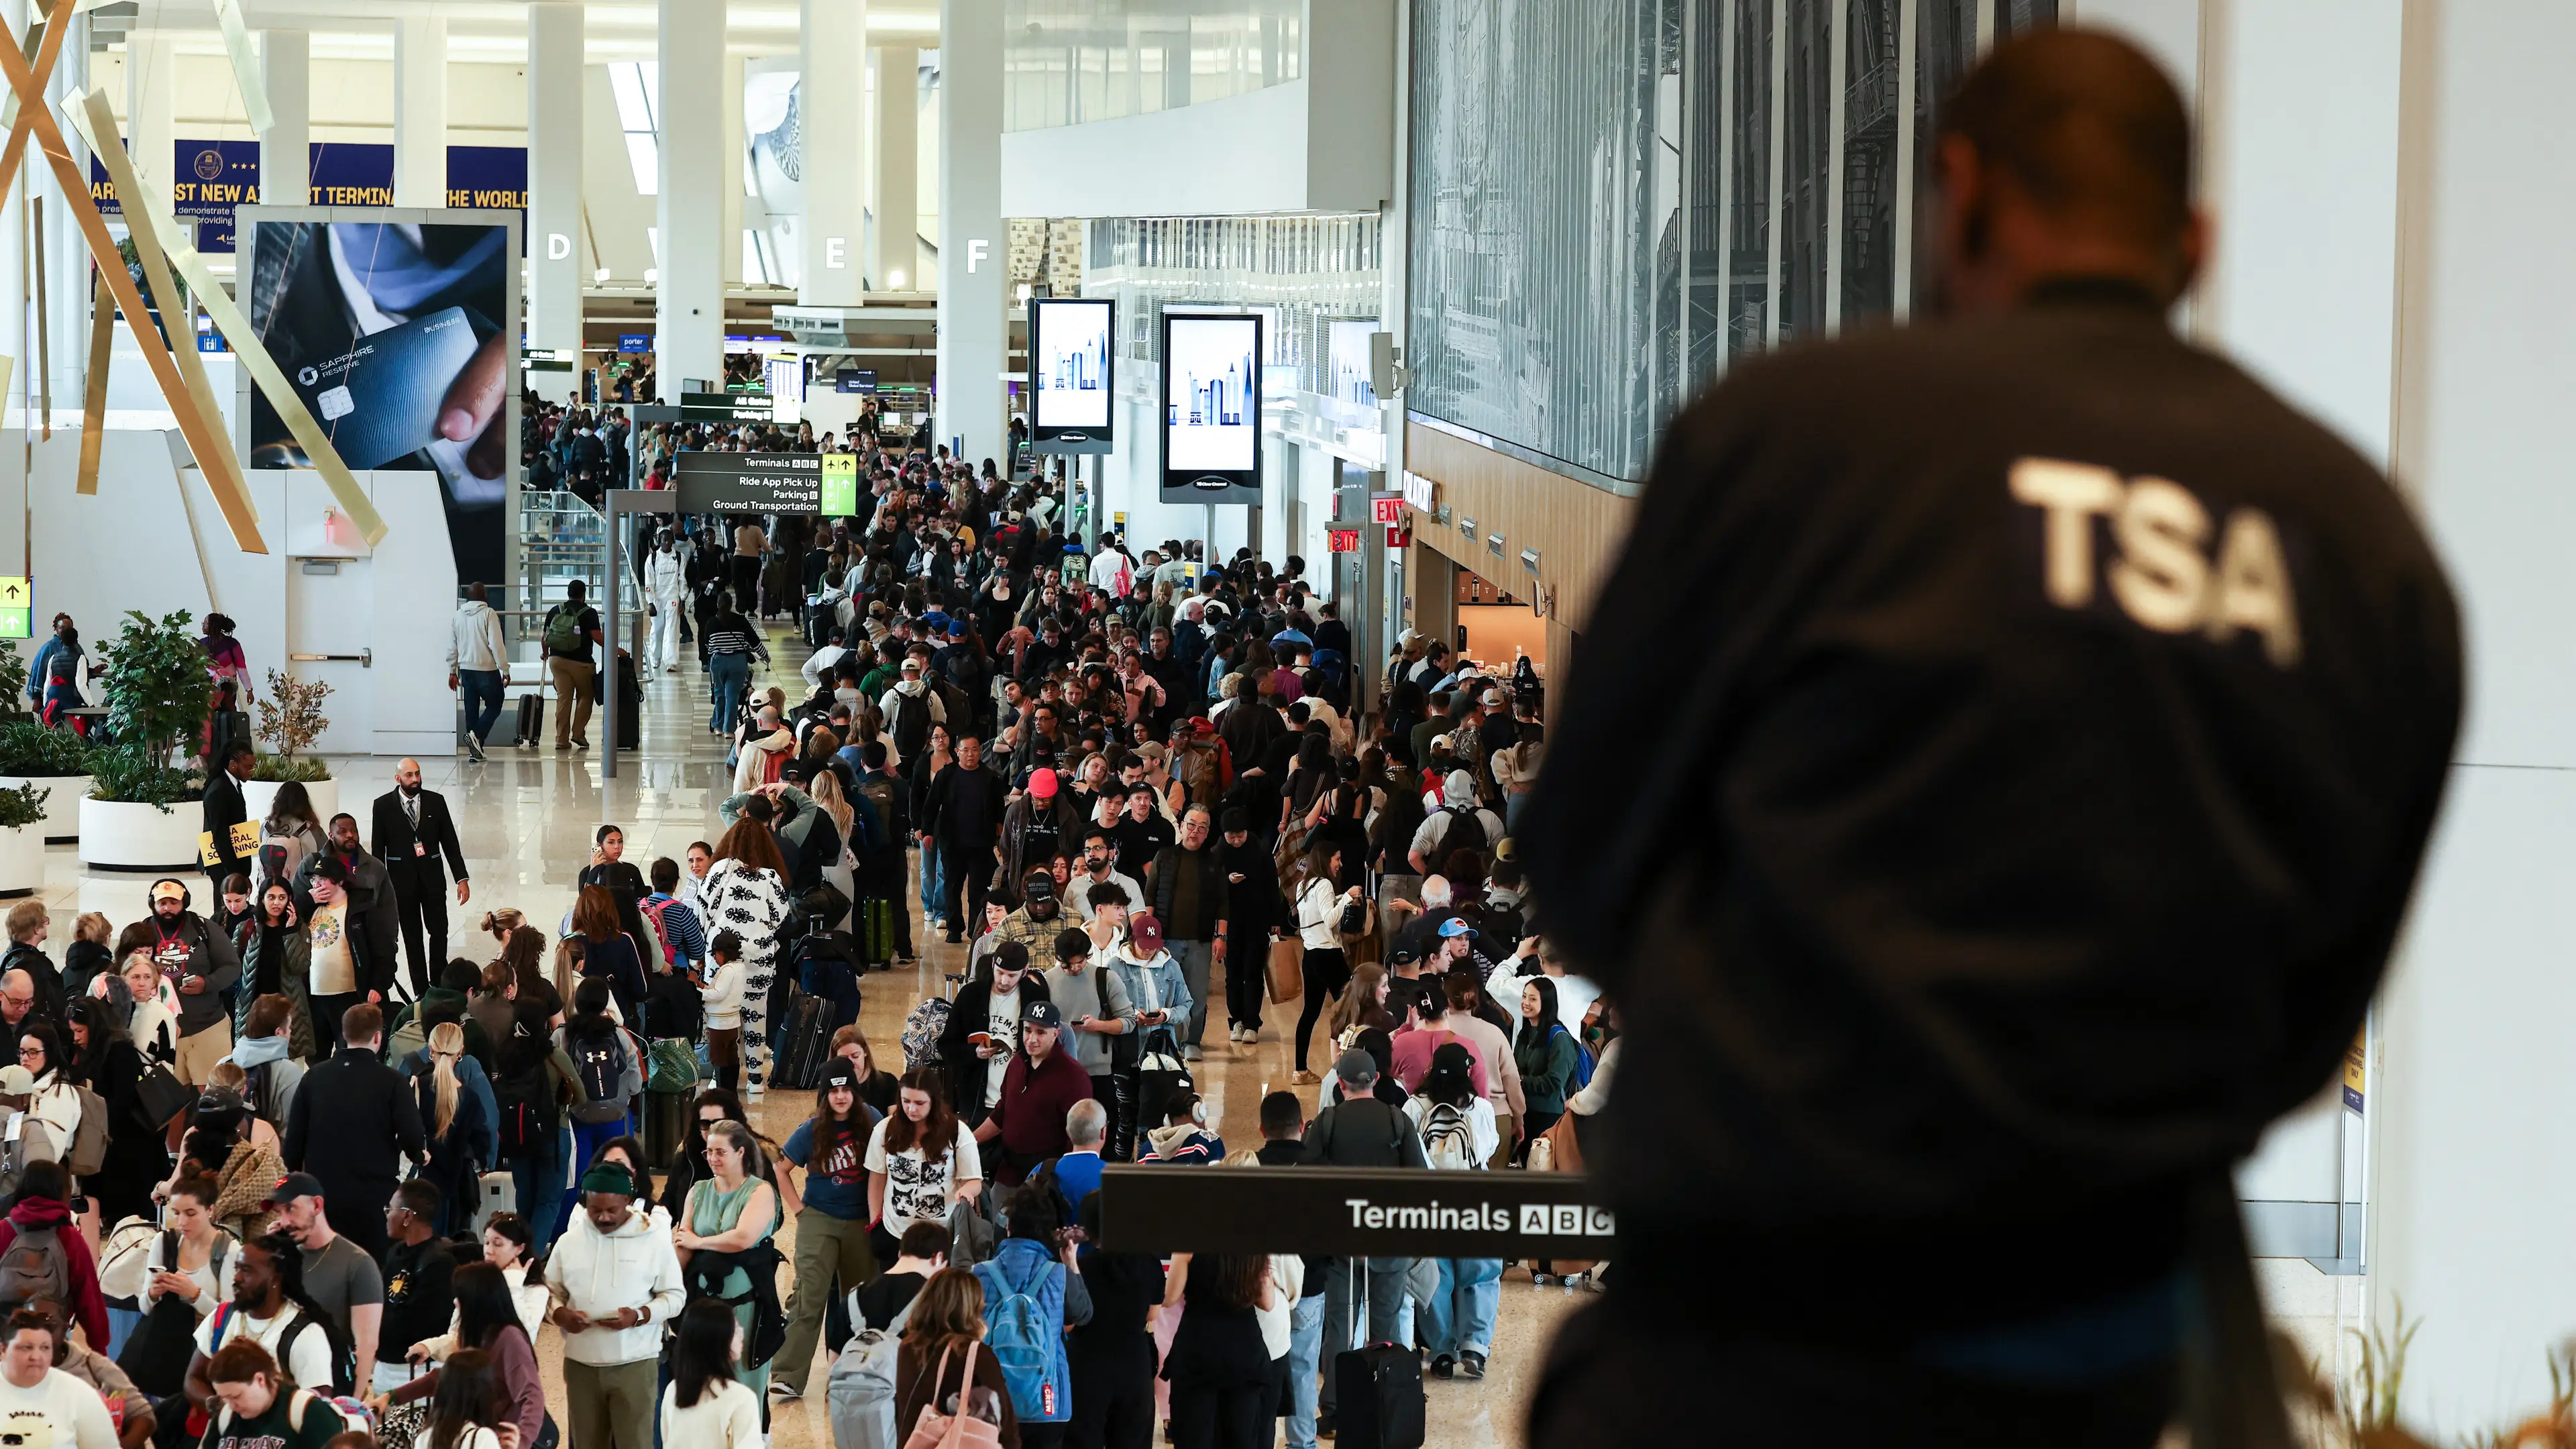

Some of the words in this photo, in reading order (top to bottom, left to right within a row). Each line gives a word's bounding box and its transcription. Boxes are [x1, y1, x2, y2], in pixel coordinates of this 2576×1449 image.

[174, 183, 197, 202] ST
[201, 183, 241, 203] NEW
[327, 186, 394, 205] TERMIN
[474, 190, 528, 209] WORLD
[178, 206, 229, 215] demonstrate
[197, 216, 233, 226] providing
[547, 233, 571, 260] D
[825, 237, 846, 269] E
[967, 239, 989, 274] F
[424, 317, 460, 333] BUSINESS
[319, 345, 374, 371] SAPPHIRE
[322, 360, 360, 378] RESERVE
[744, 458, 790, 468] Terminals
[739, 476, 760, 486] Ride
[762, 477, 782, 488] App
[783, 478, 803, 487] Pick
[805, 479, 818, 488] Up
[773, 490, 808, 501] Parking
[712, 500, 748, 510] Ground
[750, 501, 818, 512] Transportation
[1377, 500, 1404, 521] EXIT
[1332, 531, 1358, 551] EXIT
[2008, 456, 2302, 669] TSA
[210, 833, 252, 849] GRAL
[207, 841, 258, 860] SCNING
[1032, 1005, 1045, 1018] NY
[1346, 1198, 1511, 1232] Terminals
